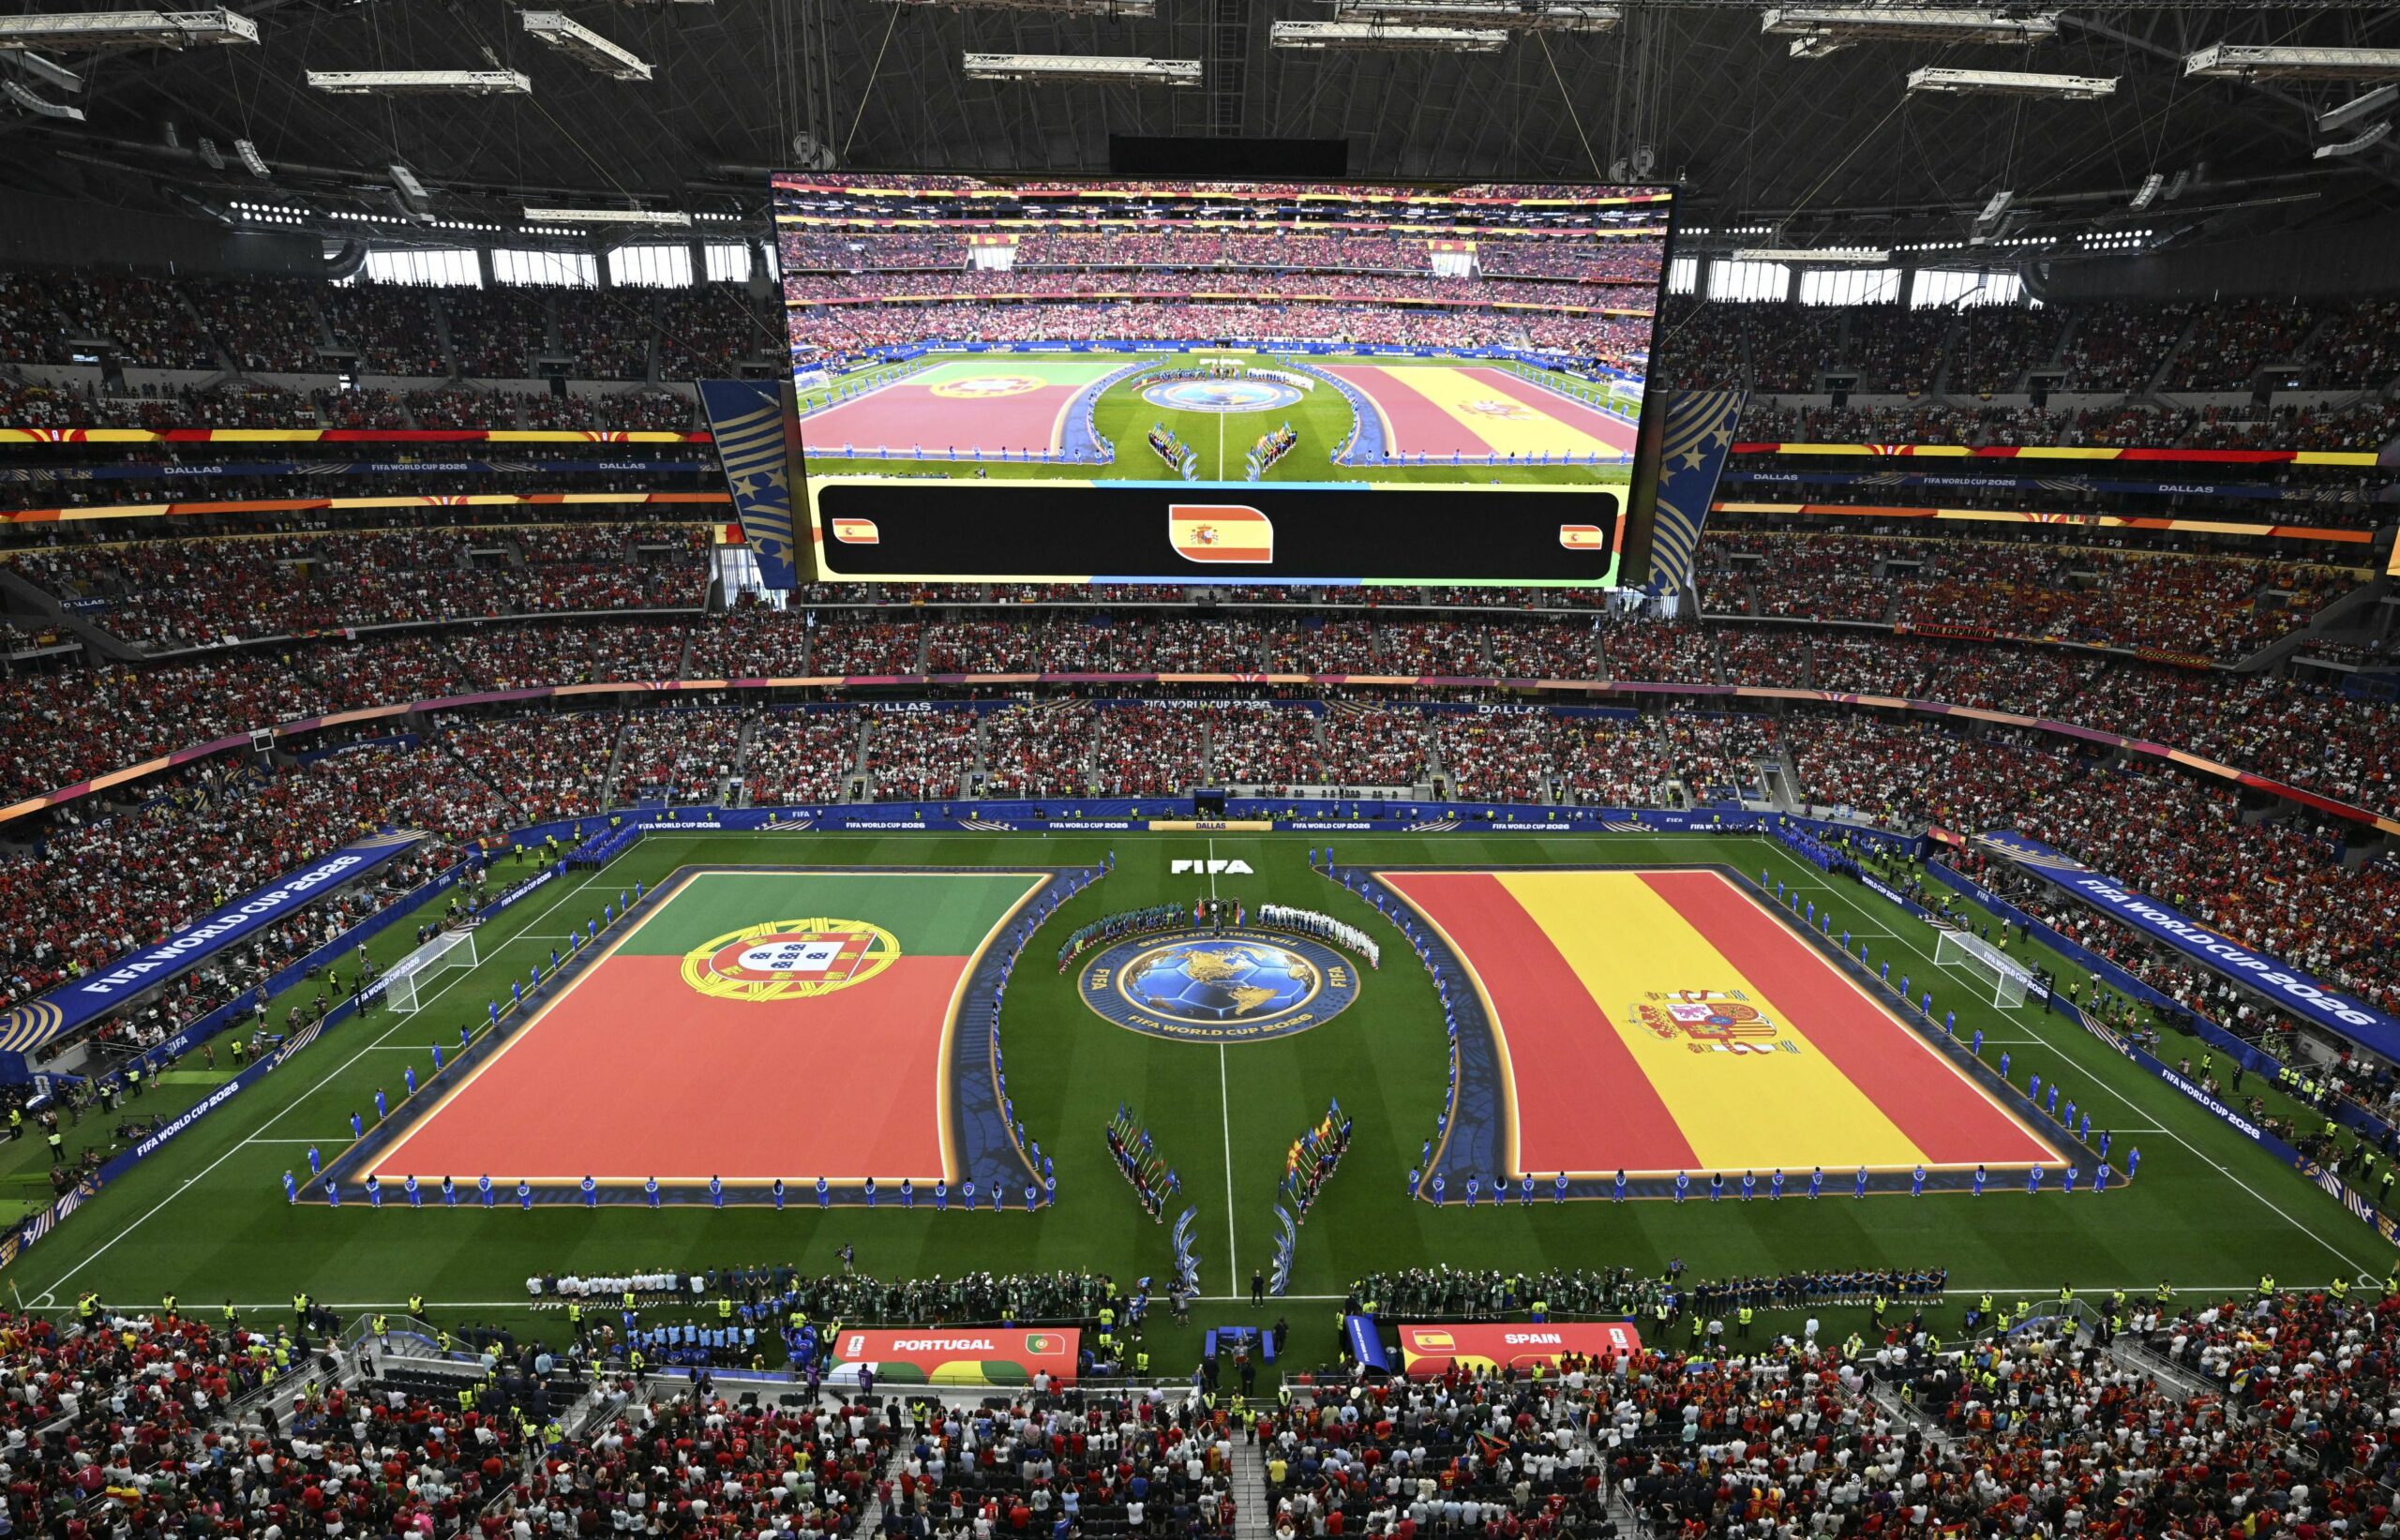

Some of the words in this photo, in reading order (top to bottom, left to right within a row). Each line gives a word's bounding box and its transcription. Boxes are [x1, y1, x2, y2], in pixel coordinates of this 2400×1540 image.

[2159, 485, 2214, 493] DALLAS
[1144, 700, 1166, 709] FIFA
[1172, 860, 1254, 874] FIFA
[439, 875, 451, 887] FIFA
[502, 896, 512, 906] FIFA
[512, 887, 528, 900] WORLD
[528, 881, 536, 890] CUP
[536, 872, 551, 885] 2026
[1862, 875, 1877, 890] WORLD
[1878, 884, 1886, 893] CUP
[1886, 890, 1903, 905] 2026
[1976, 890, 1989, 903] FIFA
[82, 962, 163, 994] FIFA
[145, 915, 248, 960] WORLD
[241, 890, 290, 914] CUP
[284, 856, 362, 890] 2026
[2076, 879, 2130, 904] FIFA
[2122, 902, 2216, 945] WORLD
[2205, 944, 2270, 974] CUP
[2257, 972, 2378, 1026] 2026
[355, 993, 369, 1007] FFA
[368, 979, 389, 996] WORLD
[389, 970, 400, 981] CUP
[400, 957, 420, 975] 2026
[1090, 967, 1111, 991] FIFA
[1327, 965, 1347, 988] FIFA
[1984, 950, 1995, 964] FIFA
[1997, 960, 2016, 977] WORLD
[2016, 972, 2027, 984] CUP
[2027, 980, 2048, 998] 2026
[1128, 1015, 1159, 1029] FIFA
[1162, 1025, 1222, 1036] WORLD
[1260, 1013, 1313, 1031] 2026
[168, 1036, 188, 1051] IFA
[2162, 1069, 2180, 1086] FIFA
[2181, 1080, 2211, 1105] WORLD
[2211, 1102, 2228, 1116] CUP
[2228, 1114, 2260, 1140] 2026
[137, 1137, 158, 1157] FIFA
[158, 1114, 190, 1141] WORLD
[191, 1101, 208, 1119] CUP
[209, 1082, 239, 1107] 2026
[892, 1339, 994, 1351] PORTUGAL
[1504, 1333, 1562, 1344] SPAIN
[85, 1470, 90, 1480] 7
